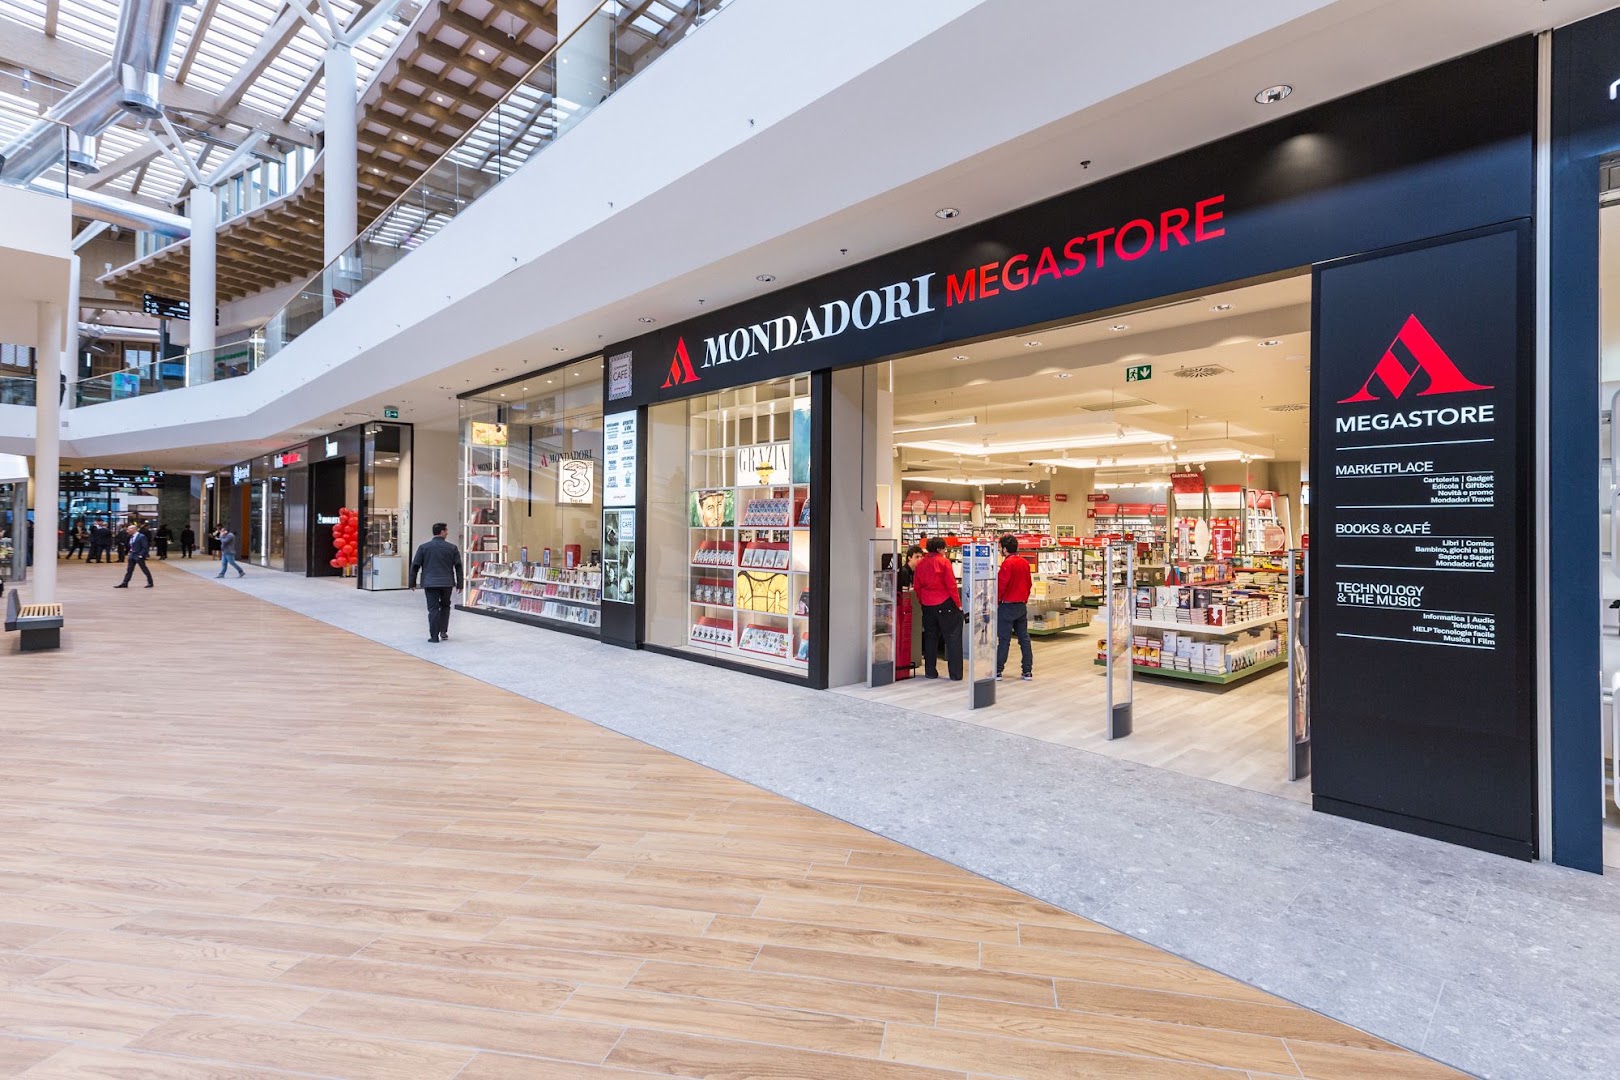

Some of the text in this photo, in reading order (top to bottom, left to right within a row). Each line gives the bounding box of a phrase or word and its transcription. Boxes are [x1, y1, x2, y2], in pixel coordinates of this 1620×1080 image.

[701, 194, 1226, 368] MONDADORI MEGASTORE
[1336, 405, 1494, 432] MEGASTORE
[1336, 461, 1433, 475] MARKETPLACE
[1336, 522, 1431, 534] BOOKS & CAFÉ
[1336, 582, 1424, 596] TECHNOLOGY
[1337, 593, 1421, 607] & THE MUSIC
[1423, 613, 1465, 622] Informatica
[1434, 628, 1472, 637] Tecnologia
[1444, 635, 1470, 643] Musica
